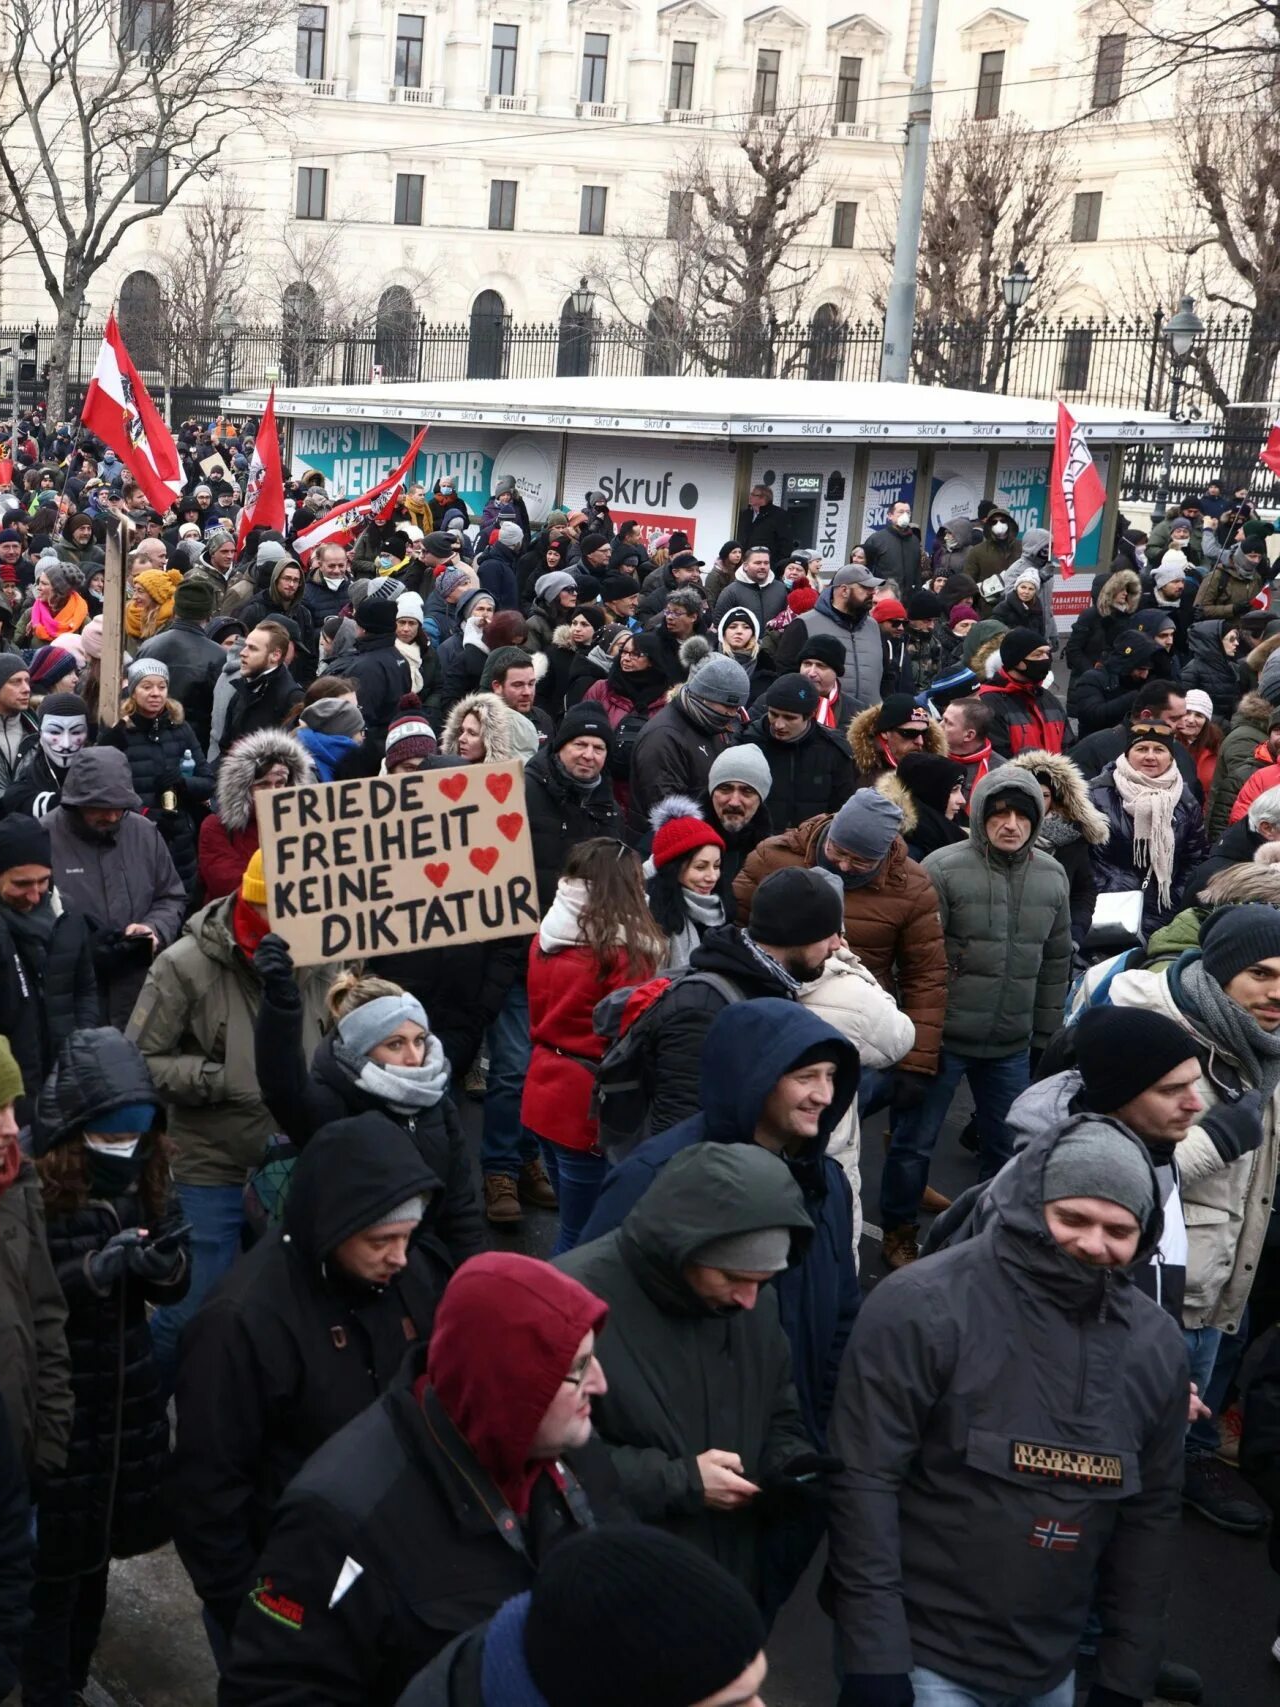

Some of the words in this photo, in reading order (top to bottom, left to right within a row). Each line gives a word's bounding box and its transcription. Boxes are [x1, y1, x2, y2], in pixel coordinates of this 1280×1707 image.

[503, 411, 520, 422] skruf
[547, 413, 566, 424] skruf
[594, 415, 615, 427] skruf
[643, 417, 665, 430] skruf
[742, 423, 766, 433] skruf
[801, 423, 825, 434] skruf
[859, 424, 883, 435] skruf
[917, 424, 940, 435] skruf
[972, 424, 994, 435] skruf
[1026, 425, 1048, 435] skruf
[1118, 426, 1139, 436] skruf
[295, 425, 352, 455] MACH'S
[359, 424, 379, 450] IM
[418, 452, 484, 492] JAHR
[871, 468, 914, 488] MACH'S
[998, 467, 1048, 488] MACH'S
[515, 476, 542, 496] skruf
[598, 468, 673, 508] skruf
[797, 478, 820, 488] CASH
[878, 488, 902, 503] MIT
[1008, 490, 1031, 507] AM
[820, 494, 840, 559] skru
[272, 775, 424, 832] FRIEDE
[276, 804, 479, 874] FREIHEIT
[274, 864, 393, 919] KEINE
[321, 875, 538, 957] DIKTATUR
